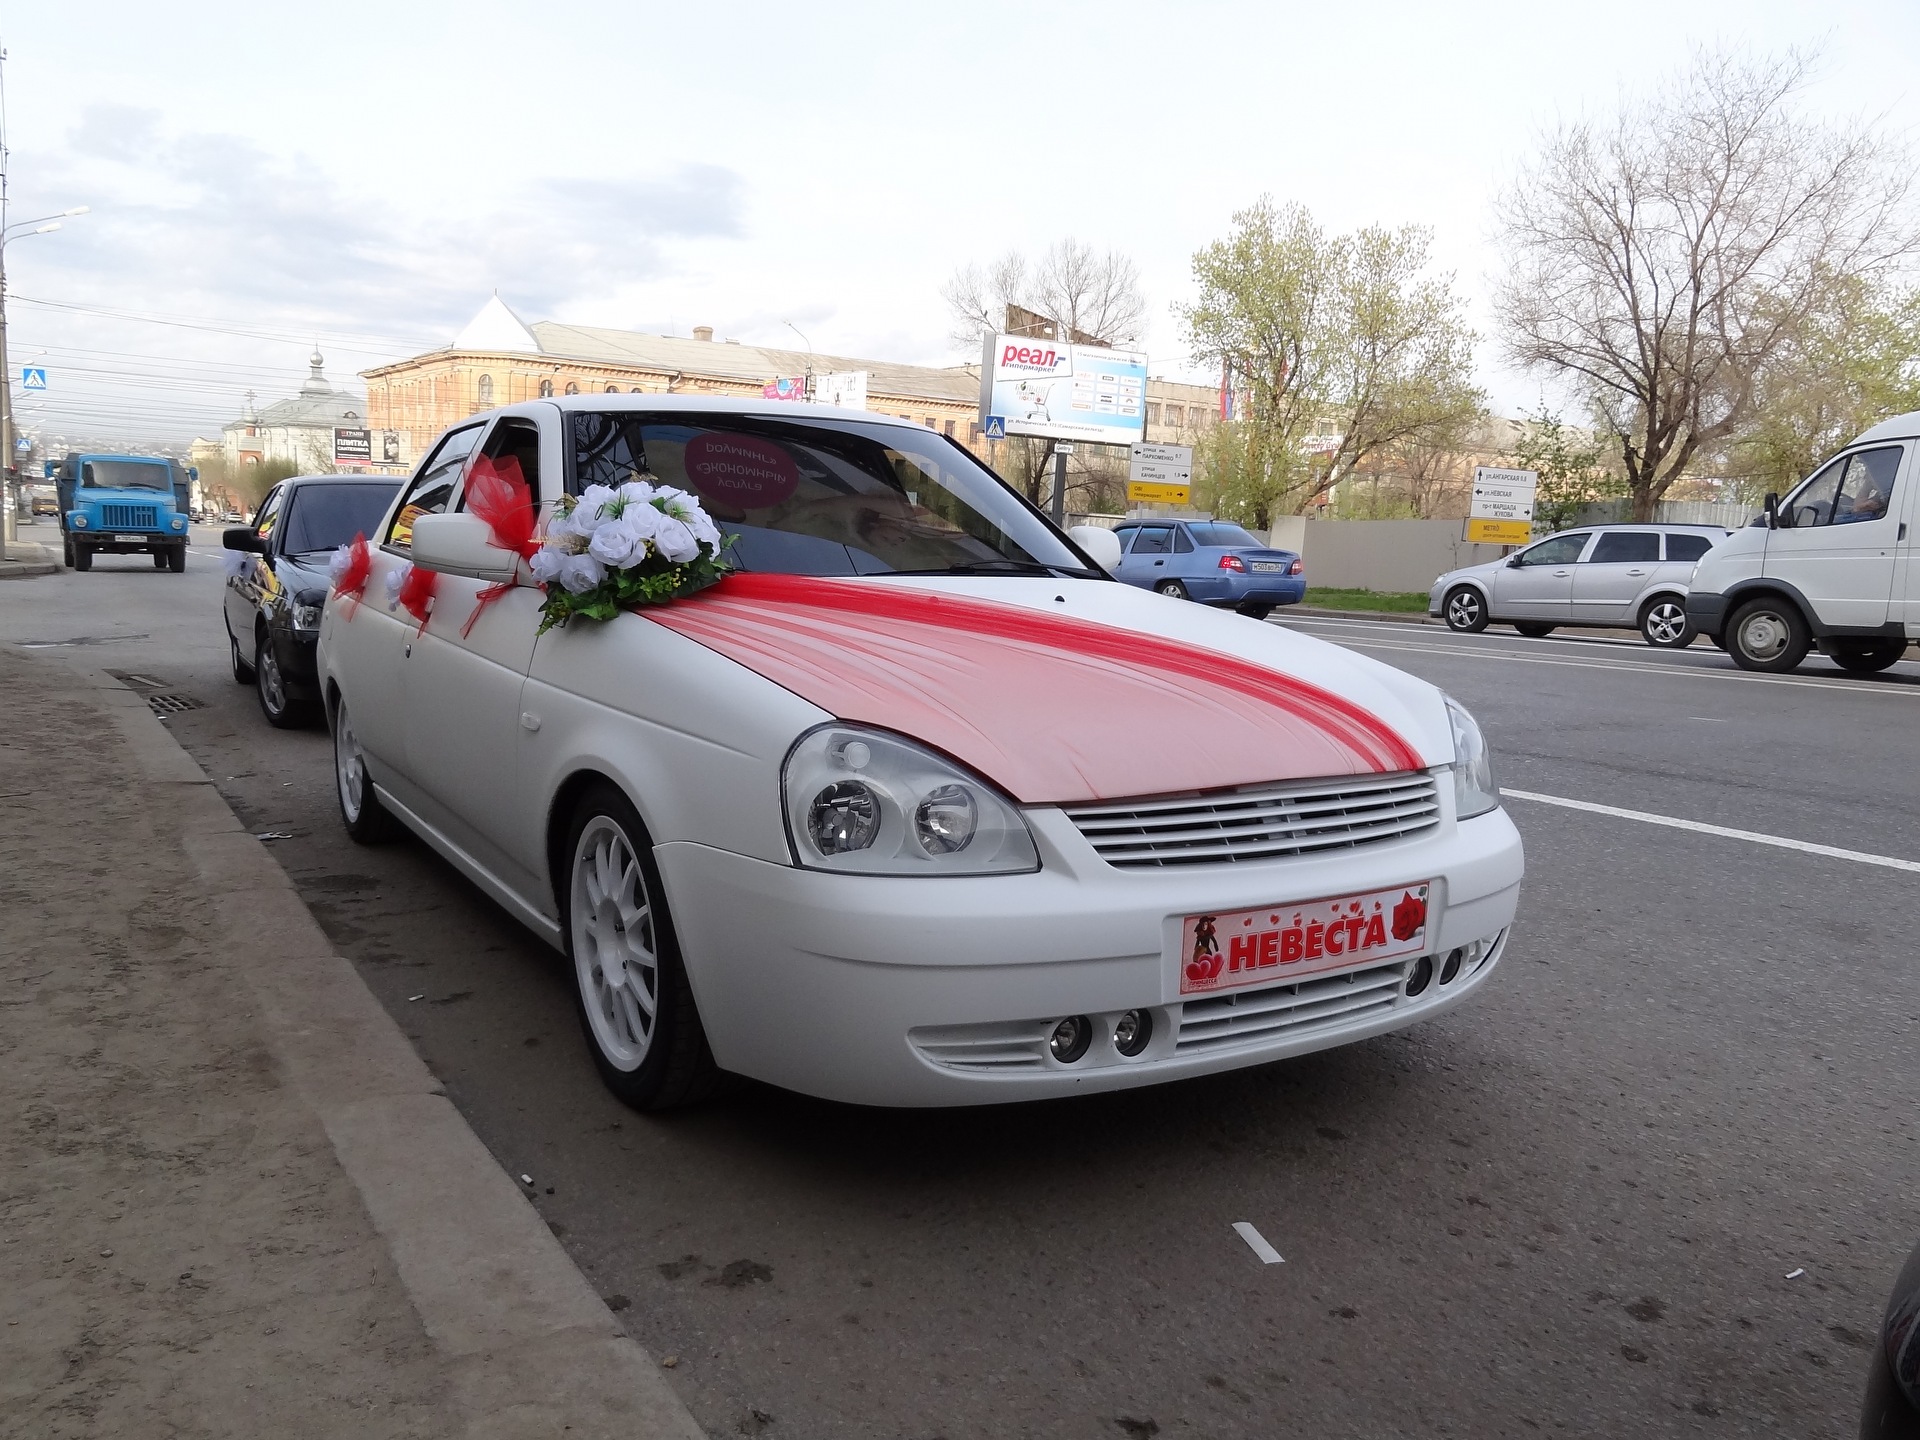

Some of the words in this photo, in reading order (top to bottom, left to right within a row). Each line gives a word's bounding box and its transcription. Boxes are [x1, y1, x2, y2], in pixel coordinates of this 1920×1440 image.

[1005, 362, 1055, 374] гипермаркет
[337, 438, 369, 447] ПЛИТКА
[1227, 911, 1388, 974] НЕВЕСТА
